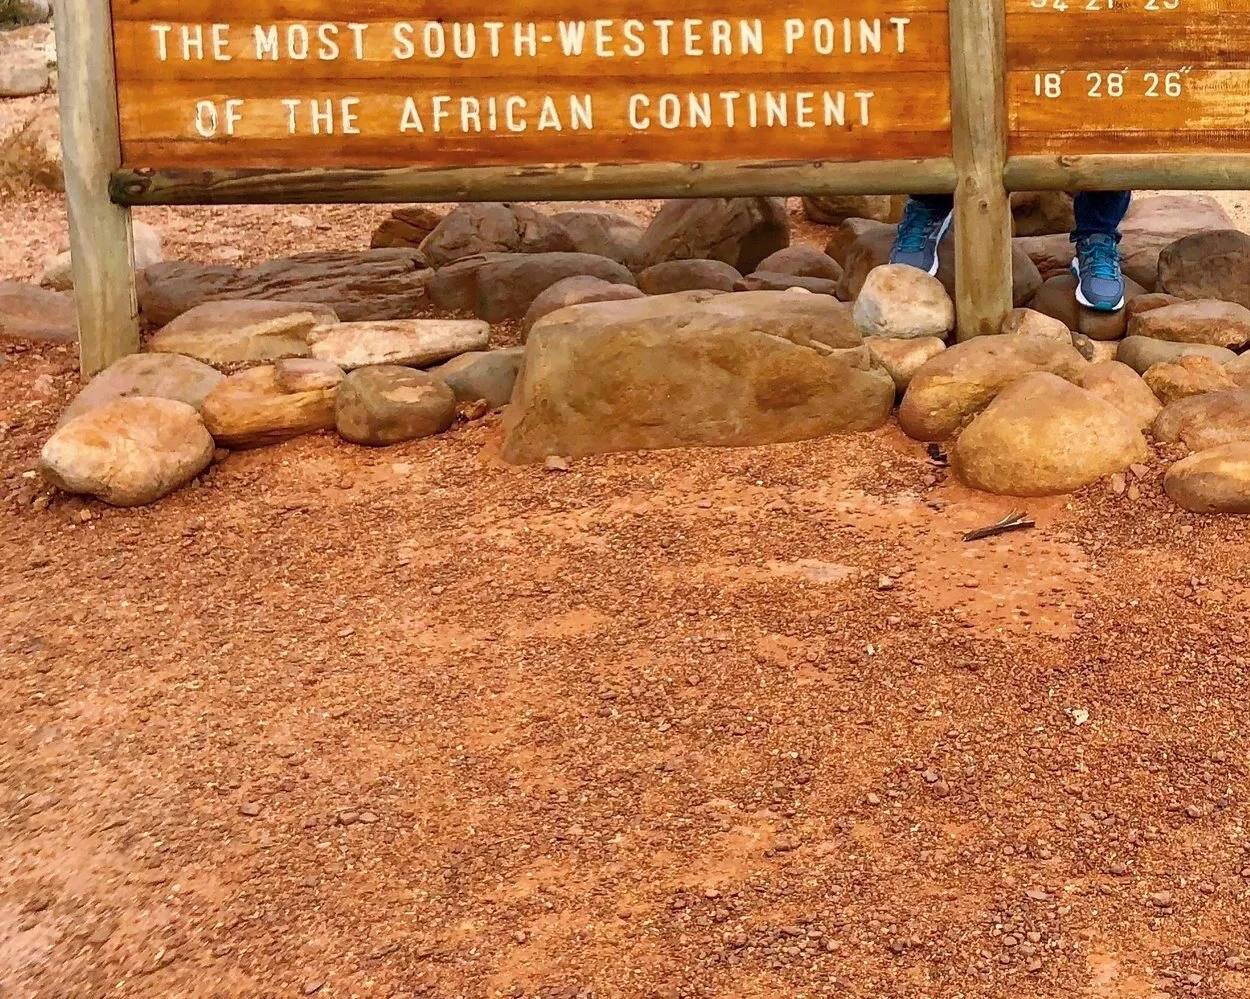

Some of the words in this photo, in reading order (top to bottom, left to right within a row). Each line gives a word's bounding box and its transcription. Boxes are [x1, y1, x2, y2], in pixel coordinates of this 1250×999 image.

[151, 23, 231, 61] THE
[253, 23, 369, 61] MOST
[392, 18, 763, 59] SOUTH-WESTERN
[785, 17, 911, 55] POINT
[195, 99, 244, 138] OF
[281, 97, 361, 135] THE
[400, 94, 594, 133] AFRICAN
[629, 91, 875, 130] CONTINENT
